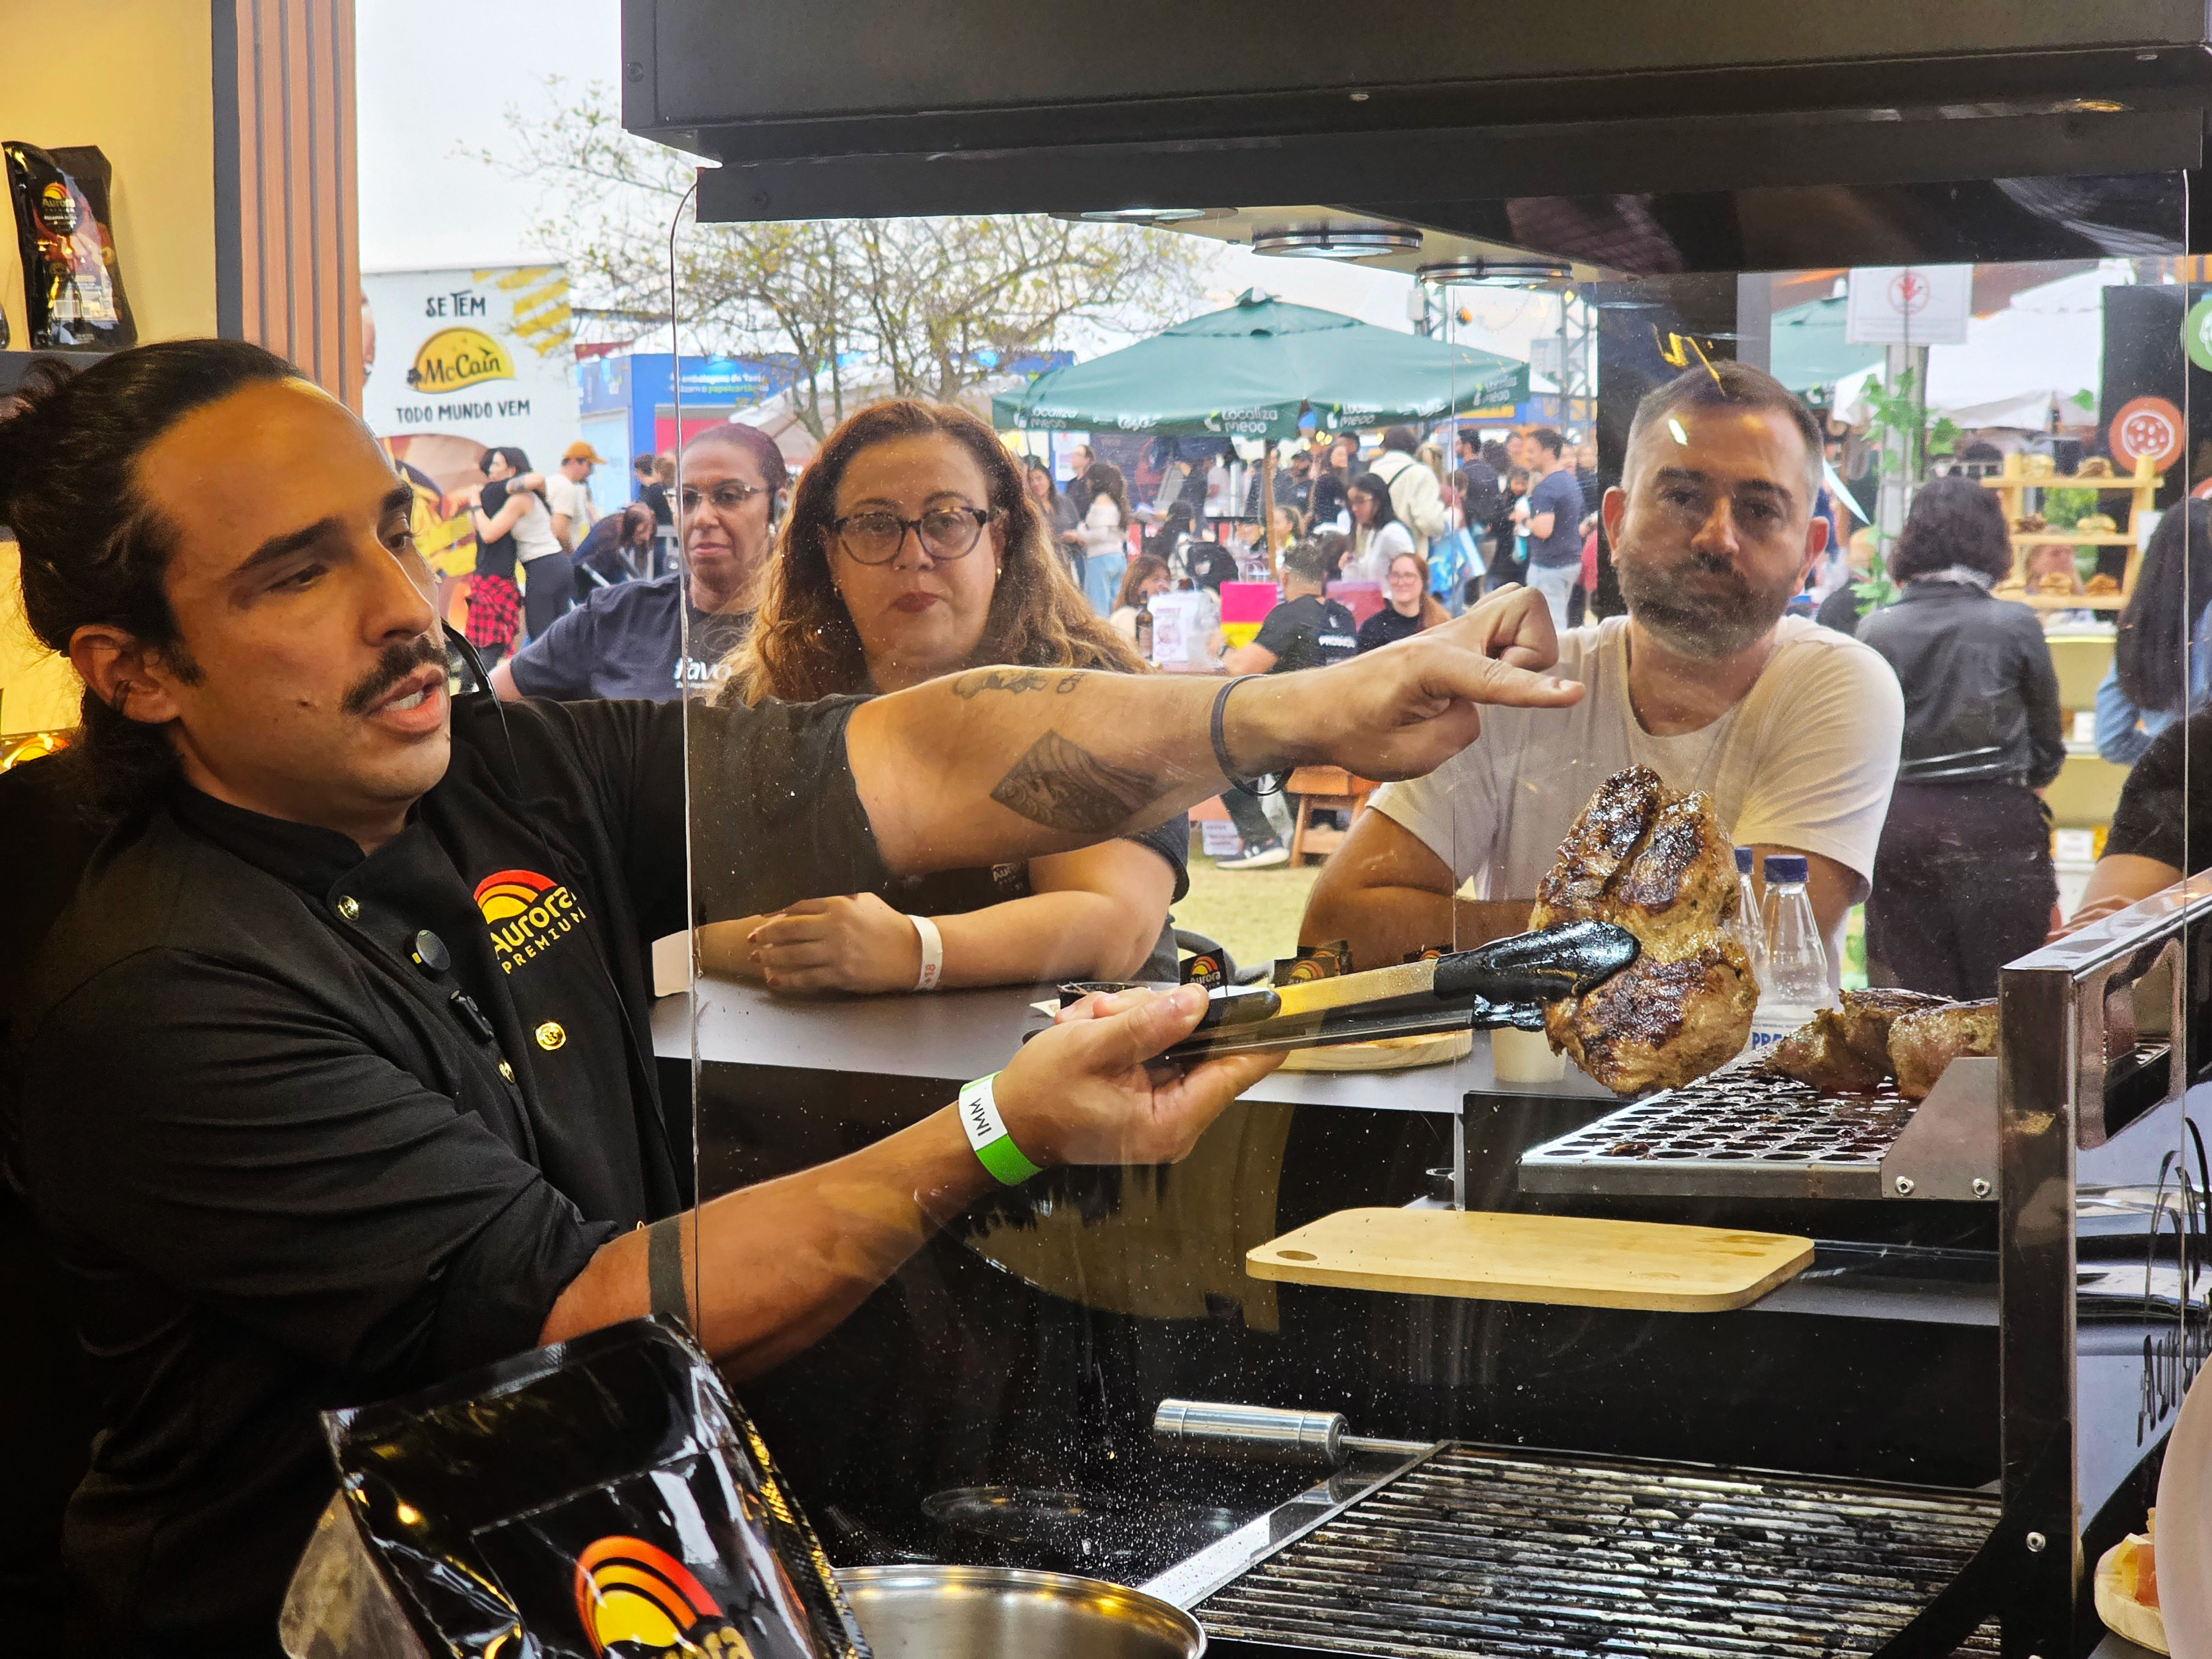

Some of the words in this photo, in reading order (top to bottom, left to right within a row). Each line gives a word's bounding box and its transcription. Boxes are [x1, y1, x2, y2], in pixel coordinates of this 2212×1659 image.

[426, 296, 448, 317] SE
[450, 289, 487, 317] TEM
[421, 352, 502, 384] McCain
[396, 404, 434, 424] TODO
[439, 401, 493, 422] MUNDO
[497, 399, 531, 417] VEM
[1222, 408, 1279, 421] Localiza
[490, 886, 577, 961] Aurora
[501, 906, 587, 974] PREMIUM
[968, 1097, 992, 1136] IMM
